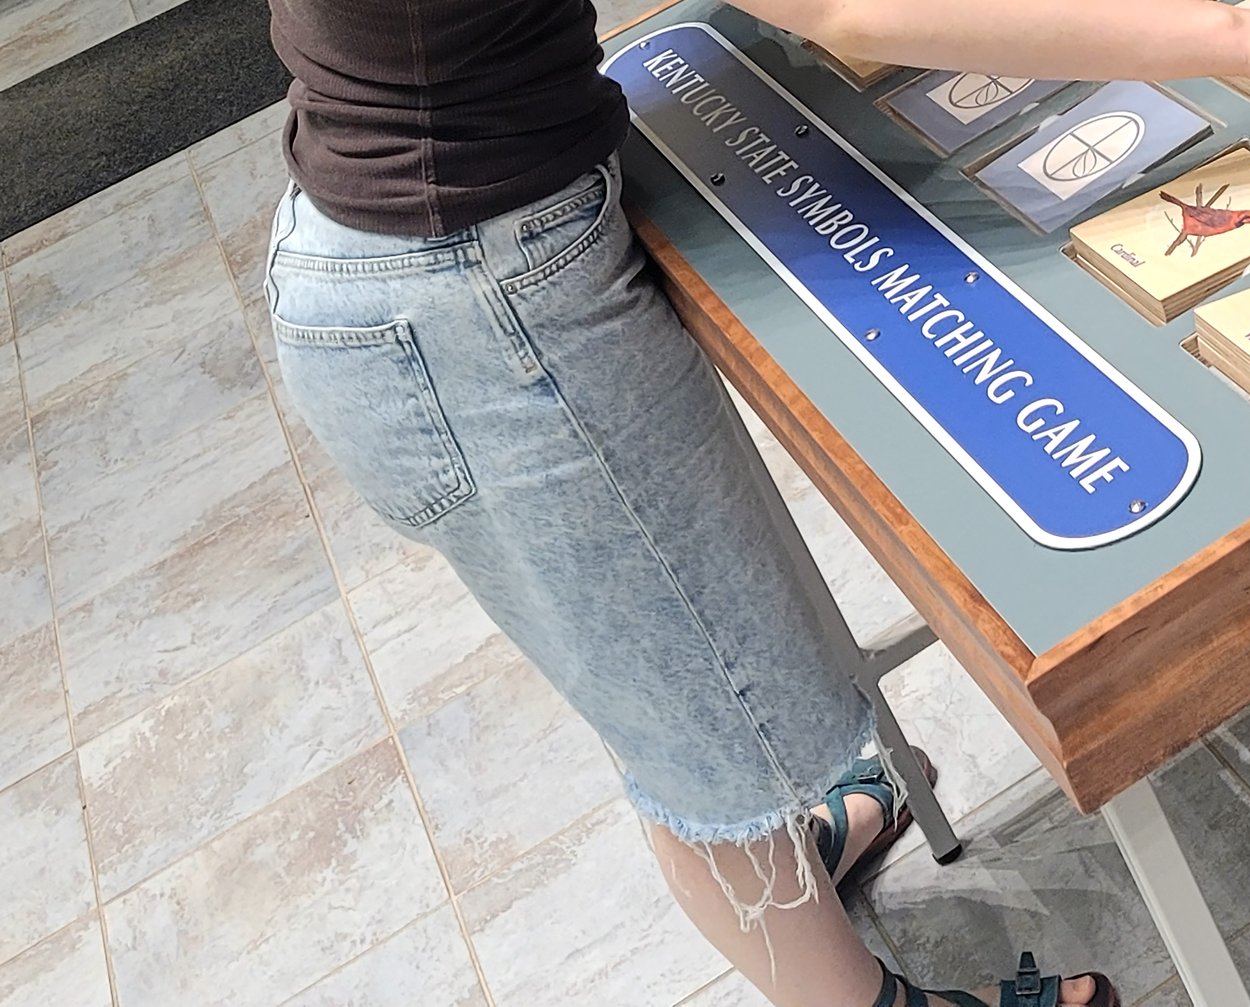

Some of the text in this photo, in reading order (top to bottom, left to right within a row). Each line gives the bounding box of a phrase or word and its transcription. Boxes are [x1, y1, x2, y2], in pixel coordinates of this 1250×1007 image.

[643, 48, 1131, 495] KENTUCKY STATE SYMBOLS MATCHING GAME
[1110, 243, 1146, 268] Cardinal
